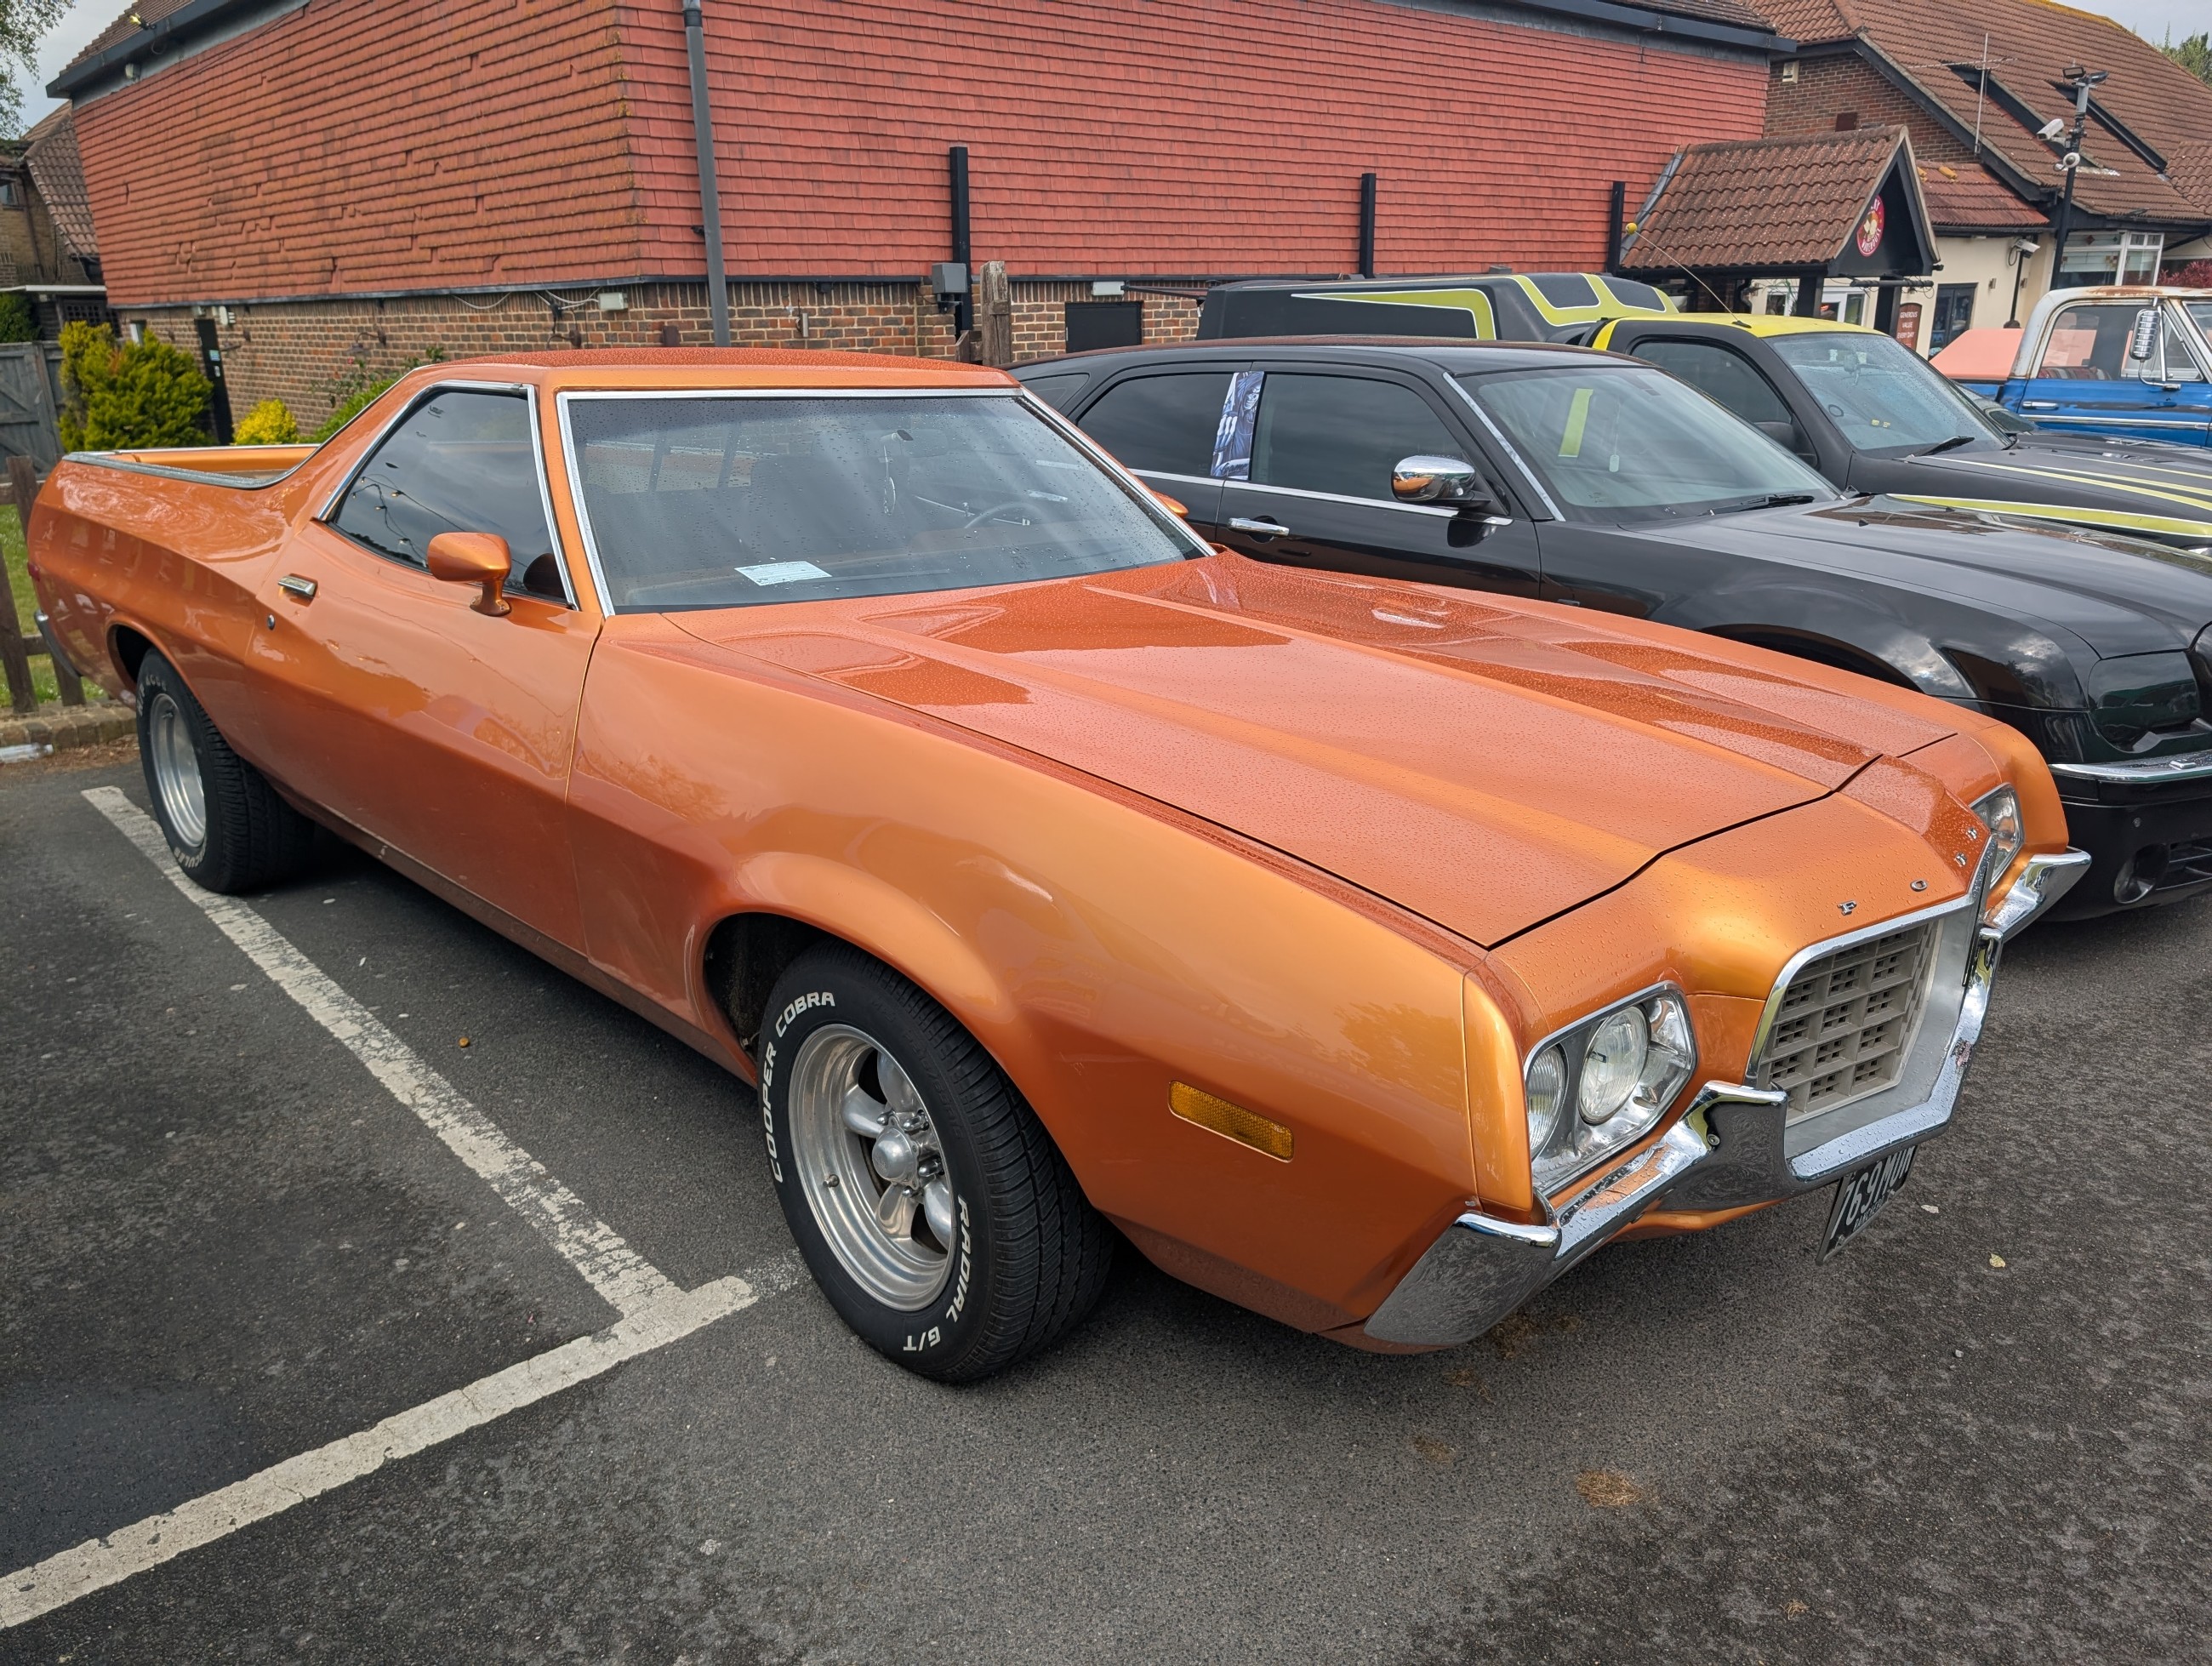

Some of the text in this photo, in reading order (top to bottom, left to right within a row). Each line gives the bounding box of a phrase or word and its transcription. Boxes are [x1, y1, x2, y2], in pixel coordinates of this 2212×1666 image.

[763, 991, 835, 1184] COOPER COBRA
[904, 1195, 972, 1352] RADIAL G/T
